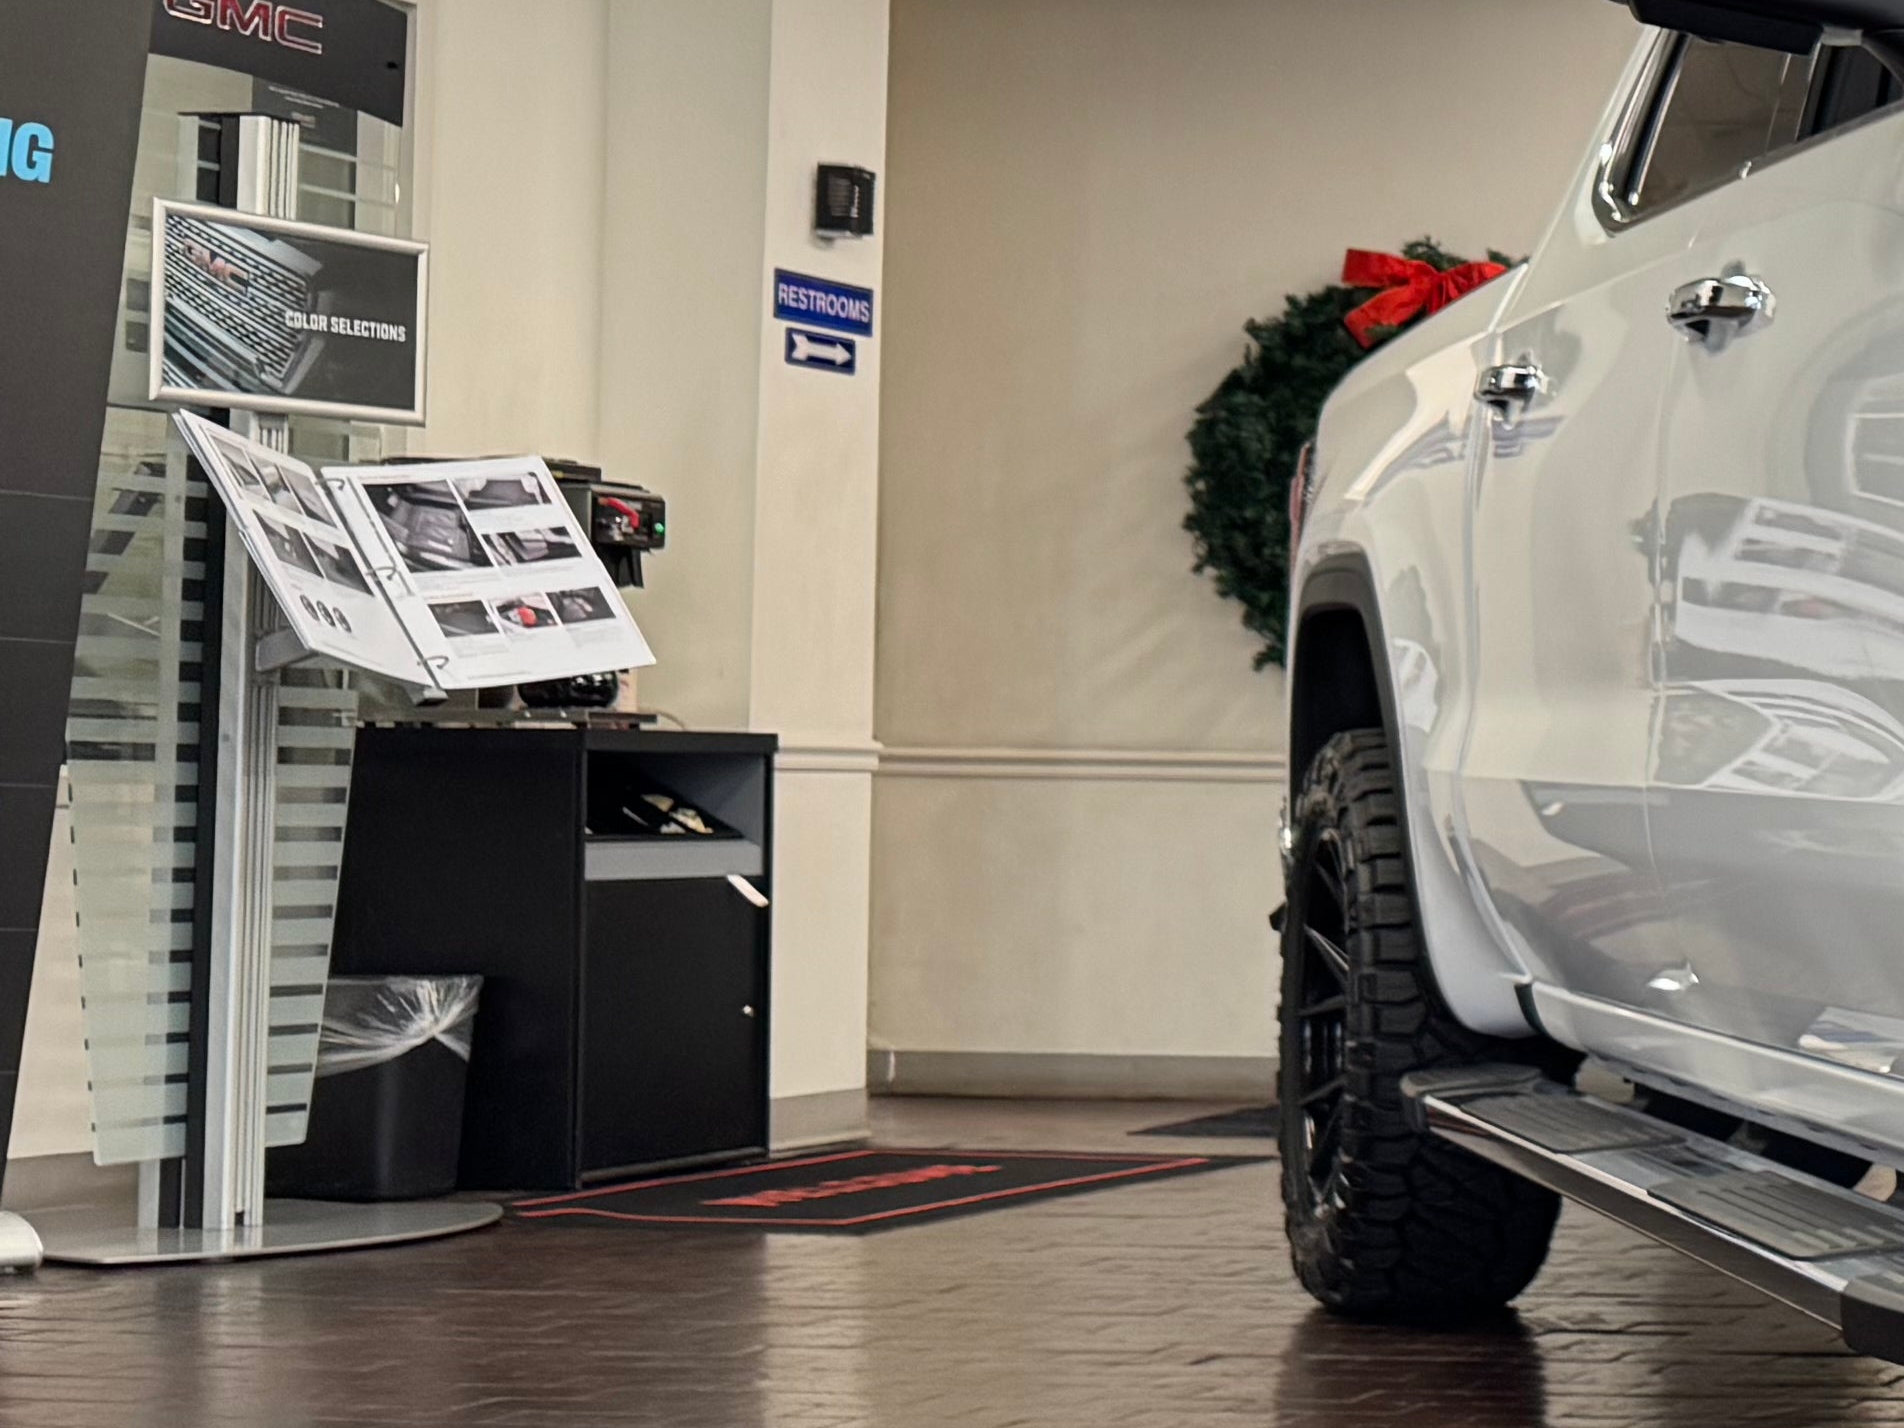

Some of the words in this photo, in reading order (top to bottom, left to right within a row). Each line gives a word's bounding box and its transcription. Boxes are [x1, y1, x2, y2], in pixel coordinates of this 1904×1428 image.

[0, 117, 54, 184] G
[778, 282, 870, 323] RESTROOMS
[284, 309, 328, 333] COLOR
[330, 314, 407, 342] SELECTIONS
